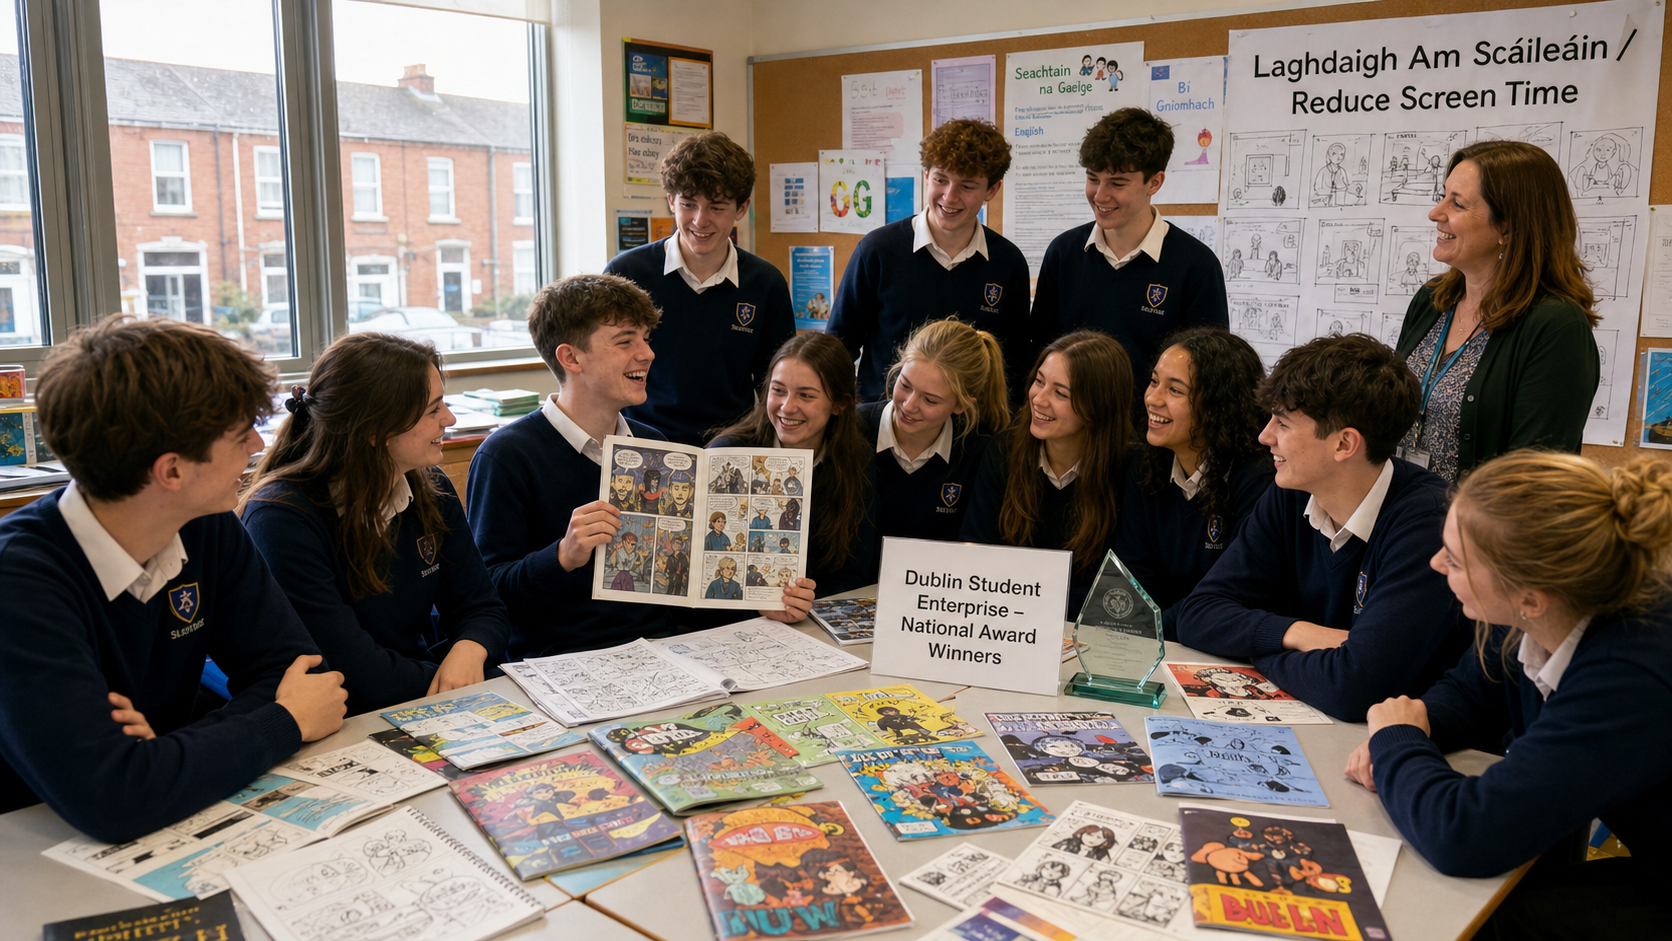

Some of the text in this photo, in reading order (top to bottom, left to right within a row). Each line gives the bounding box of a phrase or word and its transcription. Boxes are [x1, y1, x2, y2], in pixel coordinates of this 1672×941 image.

[1253, 46, 1398, 83] Laghdaigh
[1408, 44, 1461, 70] Am
[1472, 34, 1608, 66] Scáileáin
[1014, 64, 1071, 81] Seachtain
[1039, 84, 1053, 95] na
[1178, 80, 1191, 94] Bí
[1292, 80, 1579, 115] Reduce Screen Time
[904, 569, 1042, 597] Dublin Student
[917, 594, 1009, 618] Enterprise
[900, 616, 1037, 645] National Award
[928, 642, 1002, 665] Winners
